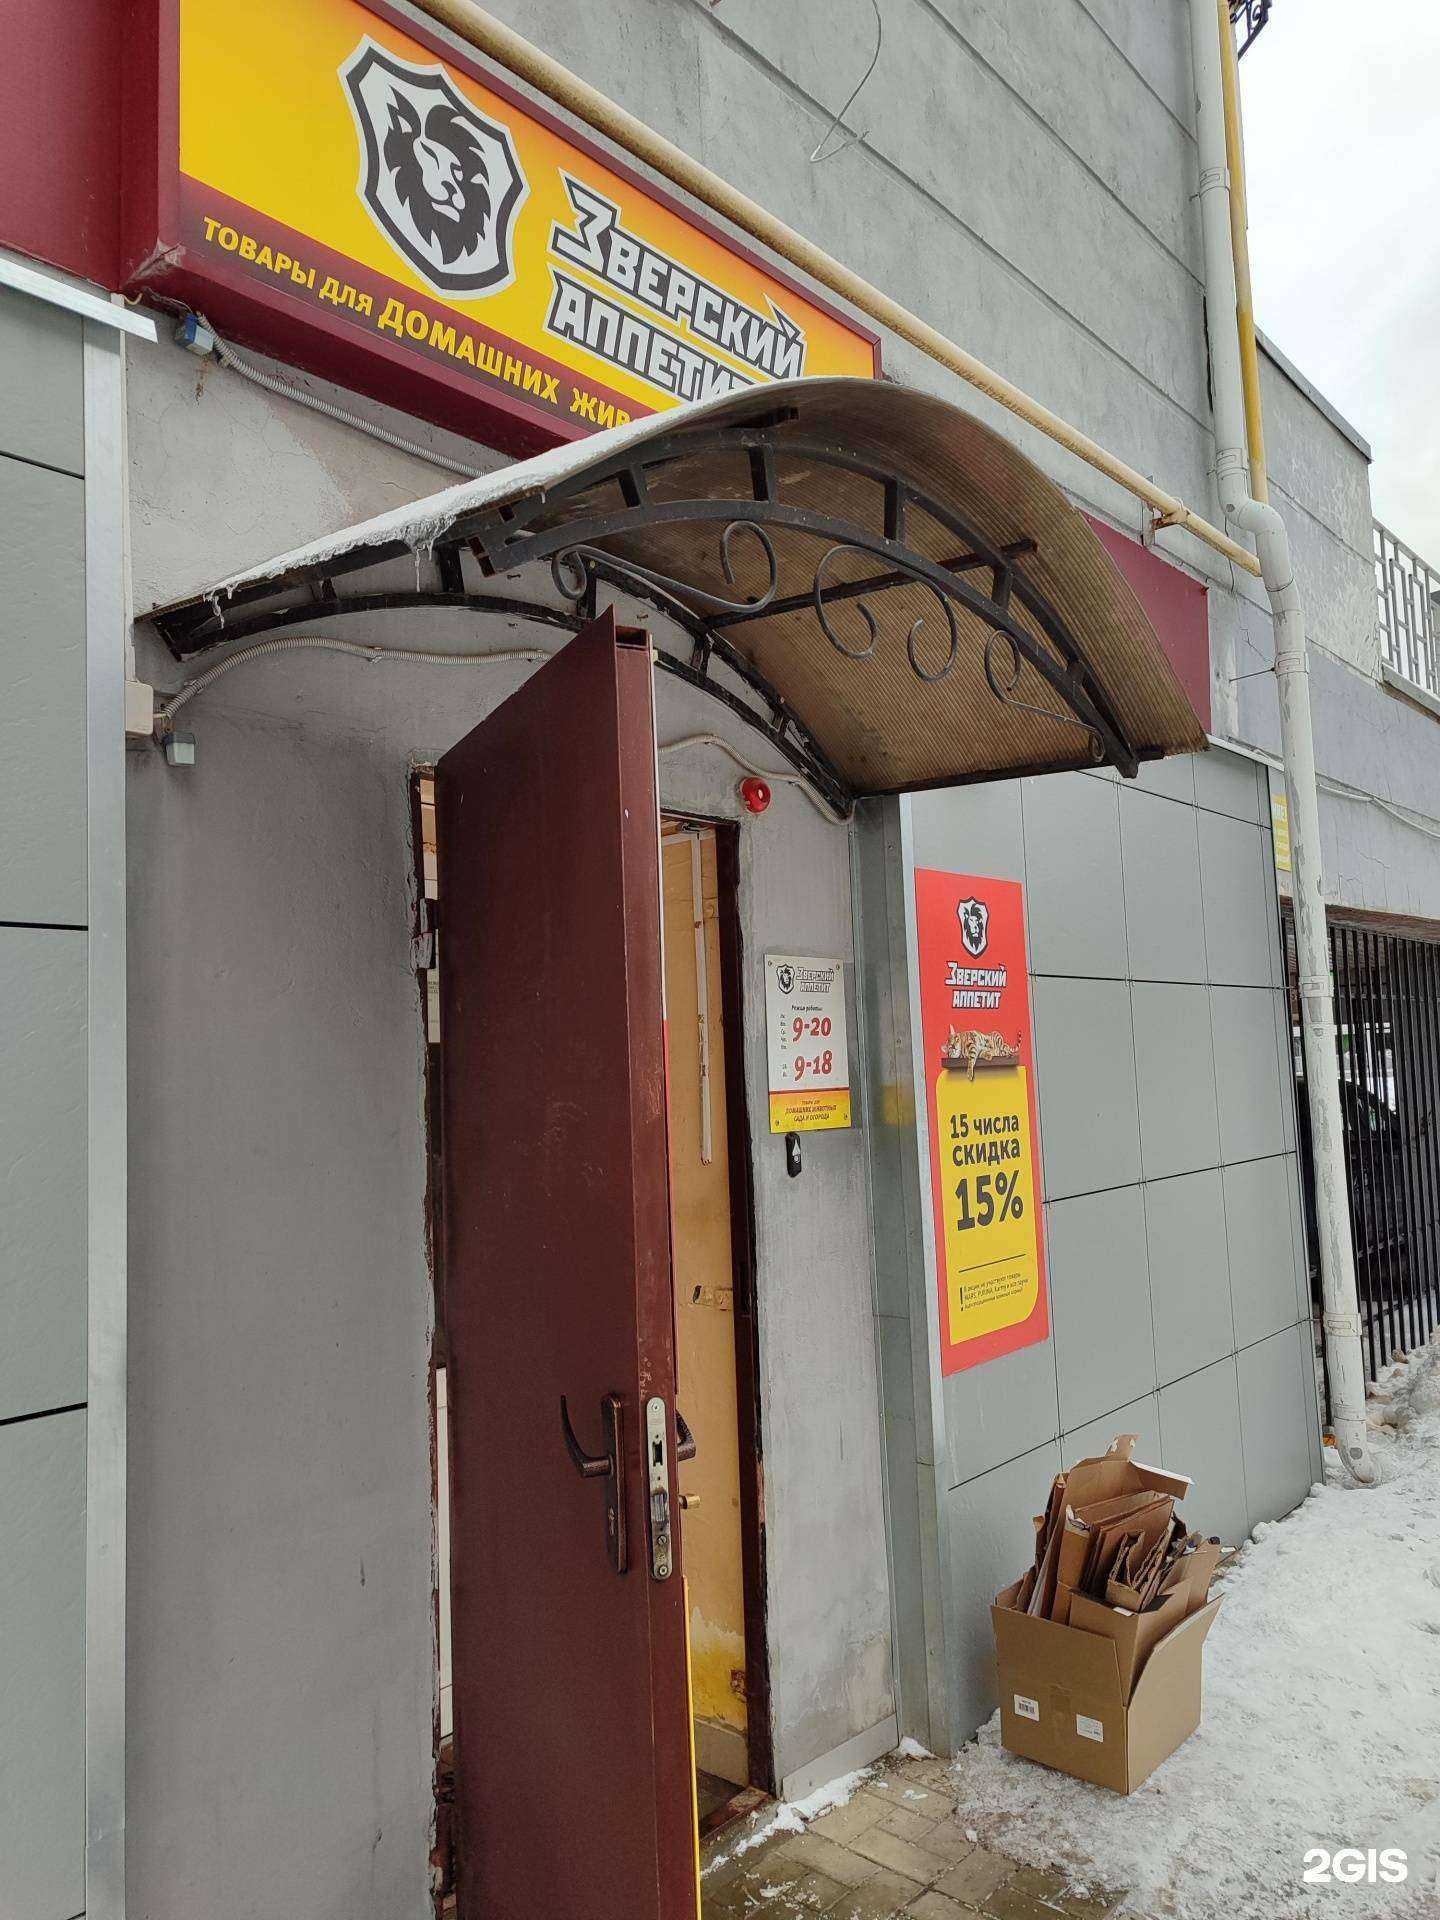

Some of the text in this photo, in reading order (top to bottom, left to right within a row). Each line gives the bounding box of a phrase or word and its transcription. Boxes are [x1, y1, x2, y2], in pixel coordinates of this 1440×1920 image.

[551, 174, 805, 380] ЗВЕРСКИЙ
[203, 216, 316, 290] ТОВАРЫ
[377, 298, 560, 404] ДОМАШНИХ
[944, 961, 1007, 987] ЗВЕРСКИЙ
[952, 989, 1001, 1009] АППЕТИТ
[793, 1016, 832, 1042] 9-20
[794, 1050, 832, 1081] 9-18
[950, 1114, 1019, 1138] 15 числа
[952, 1138, 1020, 1166] скидка
[955, 1169, 1024, 1231] 15%
